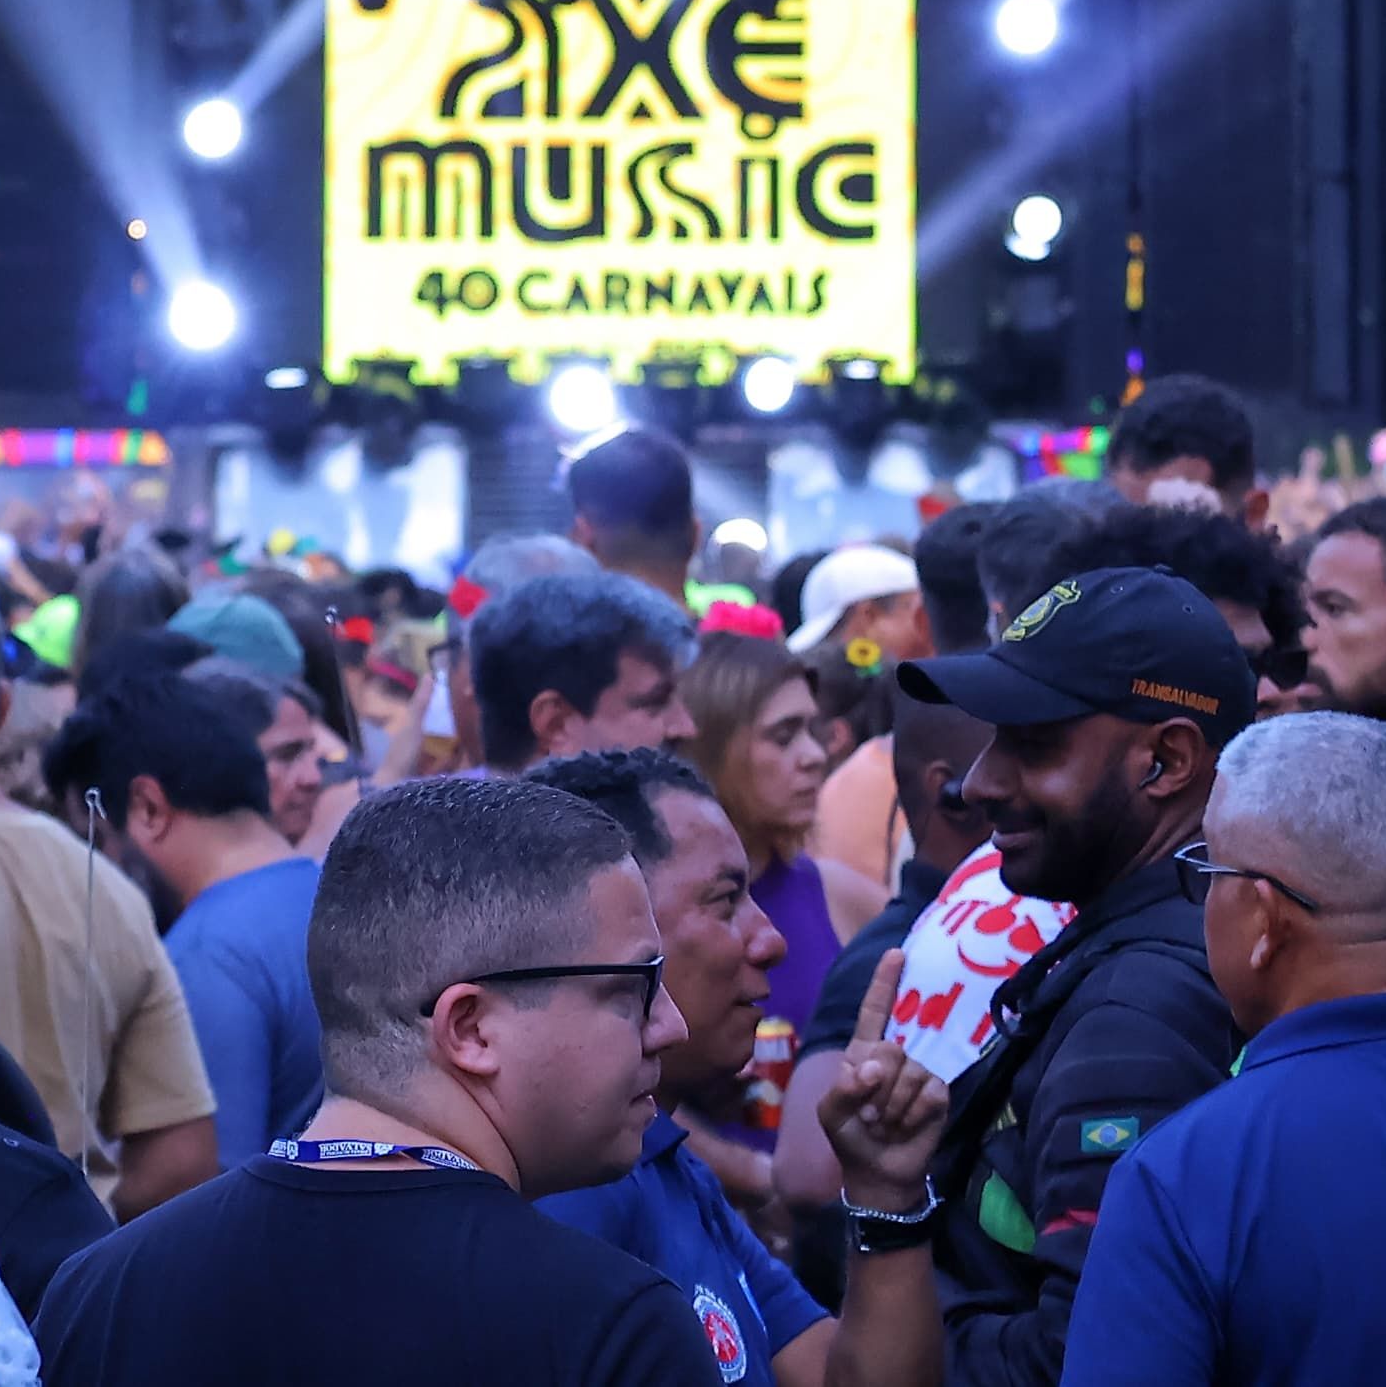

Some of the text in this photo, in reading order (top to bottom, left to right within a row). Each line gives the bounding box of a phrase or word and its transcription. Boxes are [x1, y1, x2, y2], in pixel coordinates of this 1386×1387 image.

[416, 269, 826, 317] 40 CARNAVAIS
[1132, 677, 1219, 716] TRANSALVADOR
